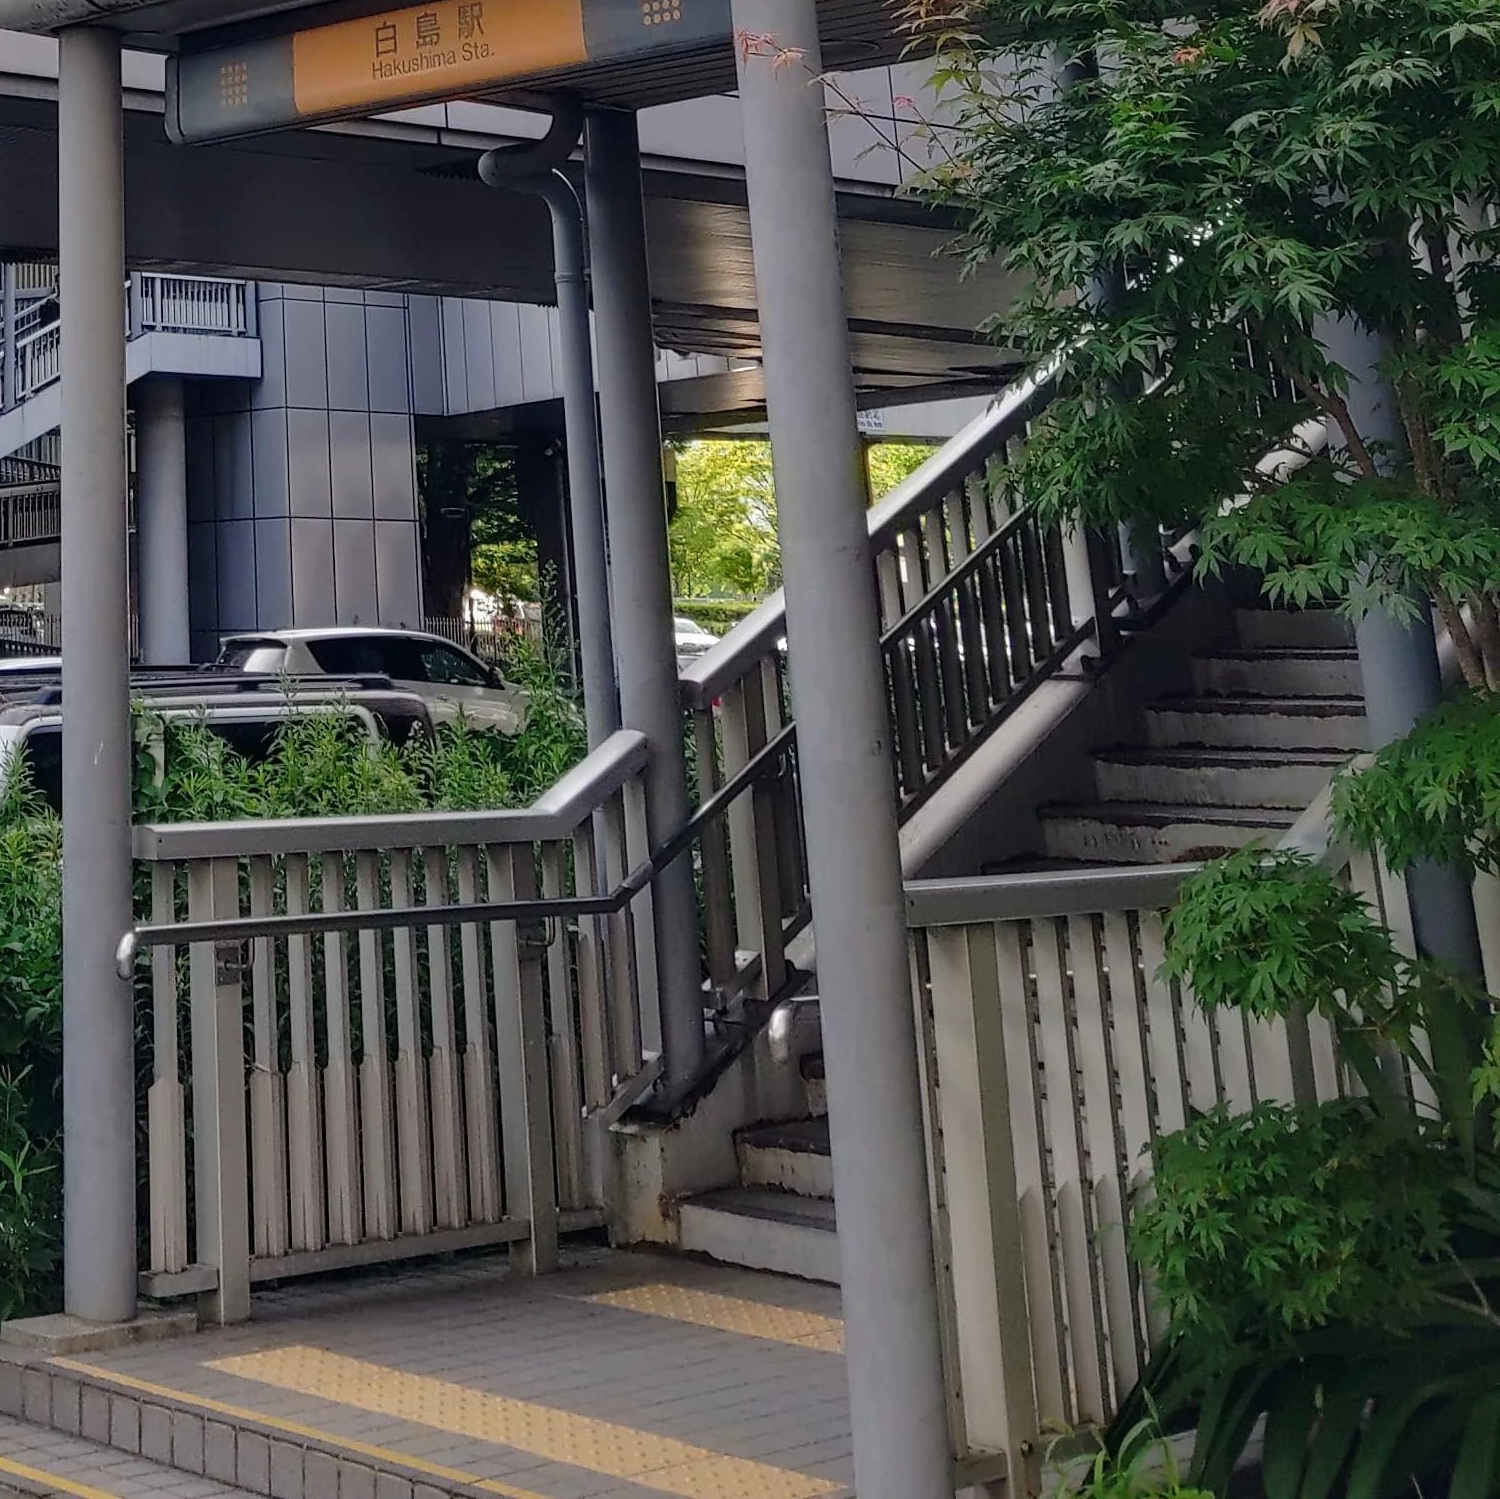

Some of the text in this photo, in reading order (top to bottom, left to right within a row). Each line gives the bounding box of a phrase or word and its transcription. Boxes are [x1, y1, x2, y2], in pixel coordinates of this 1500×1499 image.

[375, 1, 485, 58] 白島駅
[372, 41, 496, 80] Hakushima Sta.
